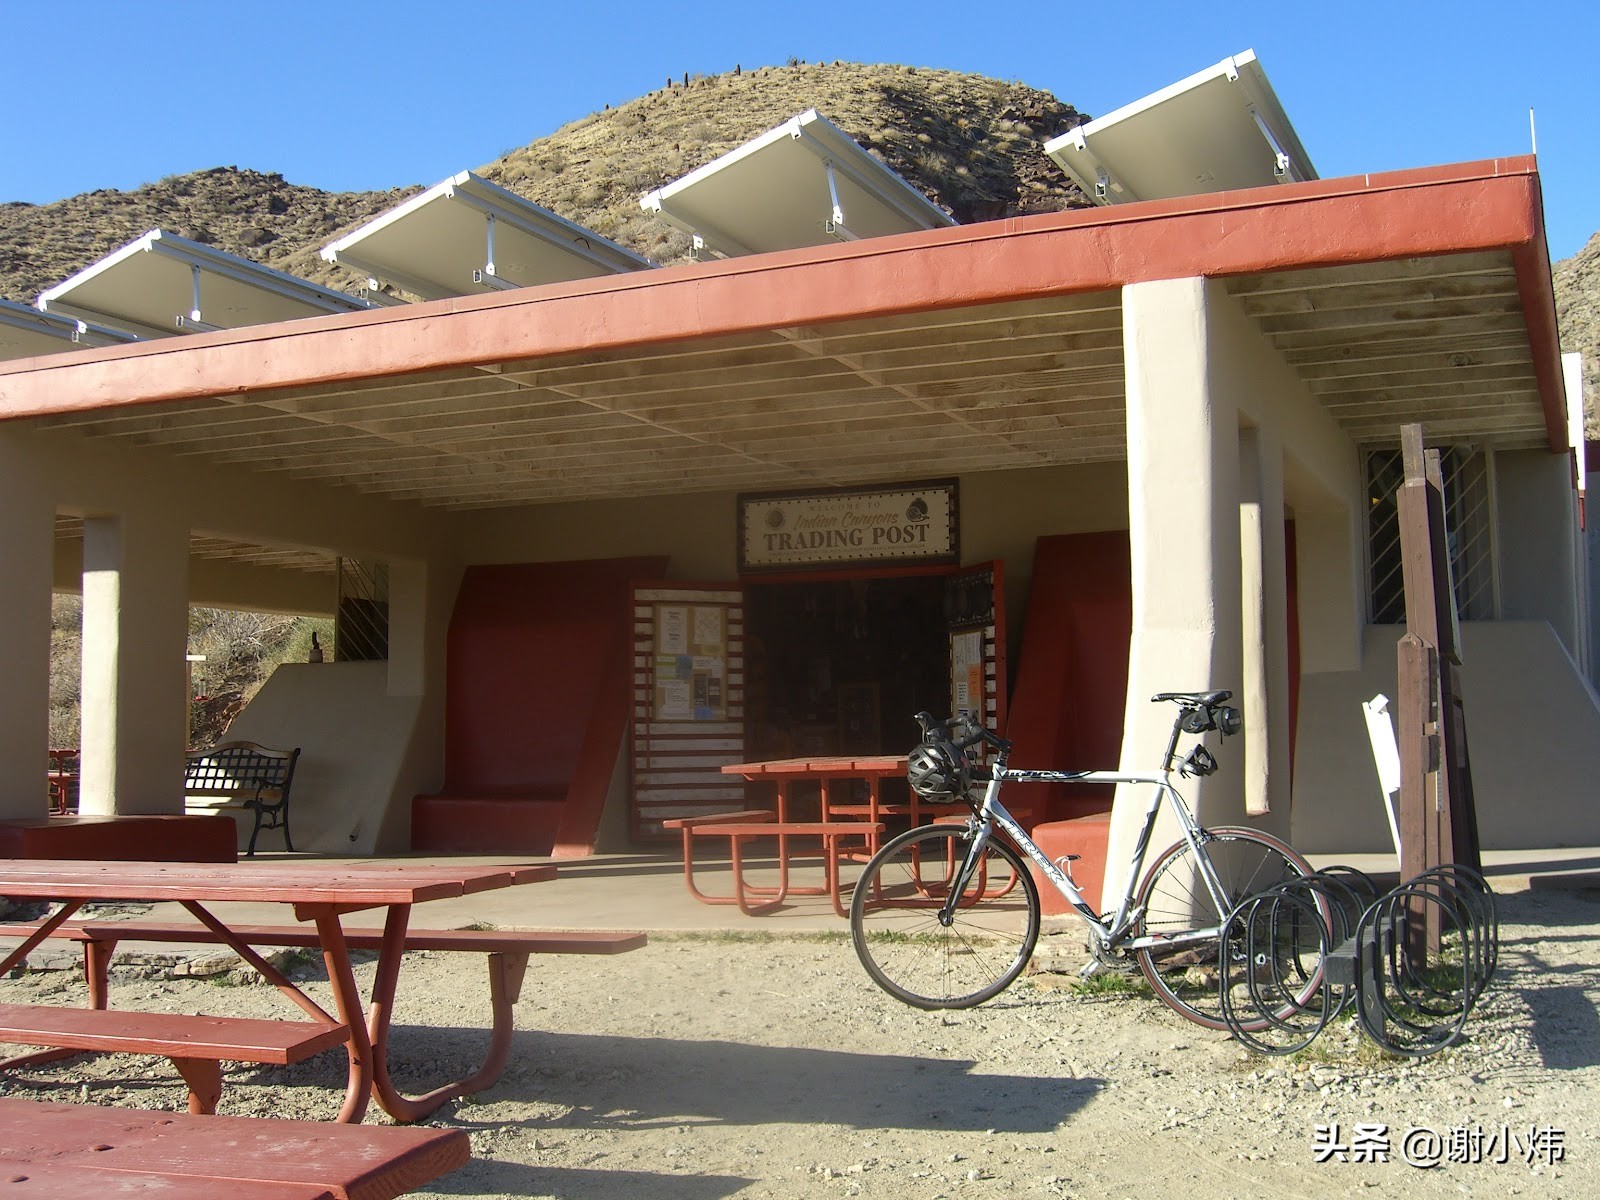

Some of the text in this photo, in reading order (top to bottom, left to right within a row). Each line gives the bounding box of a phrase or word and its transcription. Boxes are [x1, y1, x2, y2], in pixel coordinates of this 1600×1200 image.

[793, 511, 899, 531] Indian Canyons
[763, 528, 864, 551] TRADING
[872, 523, 930, 545] POST
[1009, 821, 1065, 885] TREK
